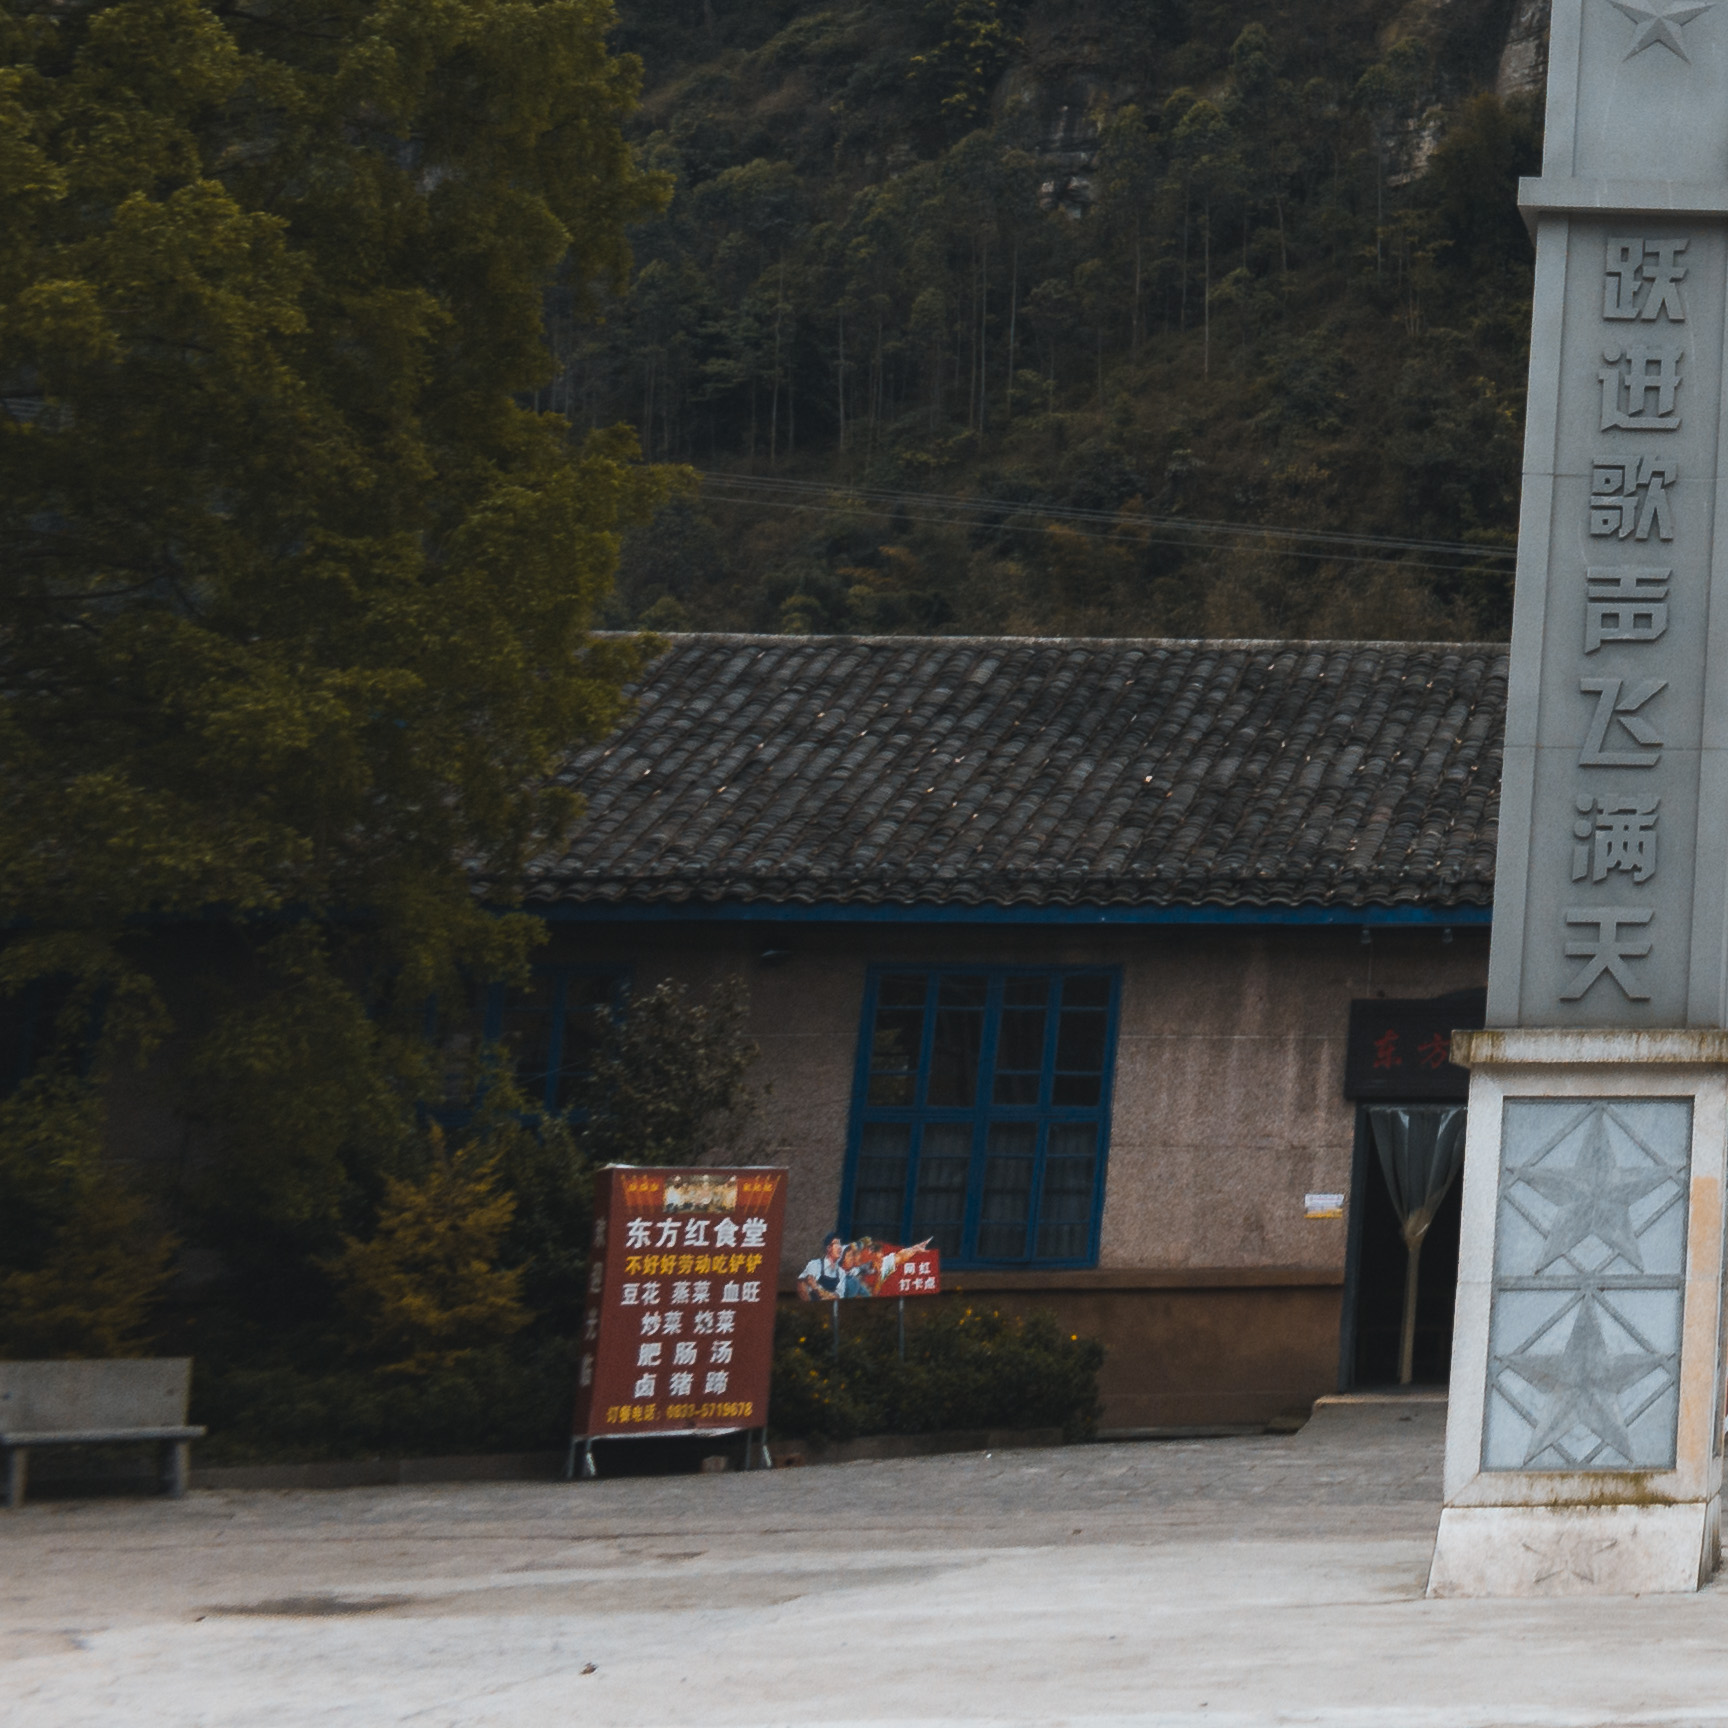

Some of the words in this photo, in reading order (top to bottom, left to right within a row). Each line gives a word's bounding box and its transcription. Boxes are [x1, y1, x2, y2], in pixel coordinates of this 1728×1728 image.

[1560, 237, 1690, 1003] 跃进歌声飞满天
[626, 1217, 768, 1248] 东方红食堂
[625, 1253, 763, 1276] 不好好劳动吃铲铲
[620, 1281, 661, 1306] 豆花
[671, 1280, 712, 1305] 蒸菜
[720, 1280, 761, 1303] 血旺
[899, 1276, 936, 1291] 打卡点
[640, 1310, 684, 1336] 炒菜
[637, 1340, 733, 1366] 肥肠汤
[634, 1370, 730, 1398] 卤猪蹄
